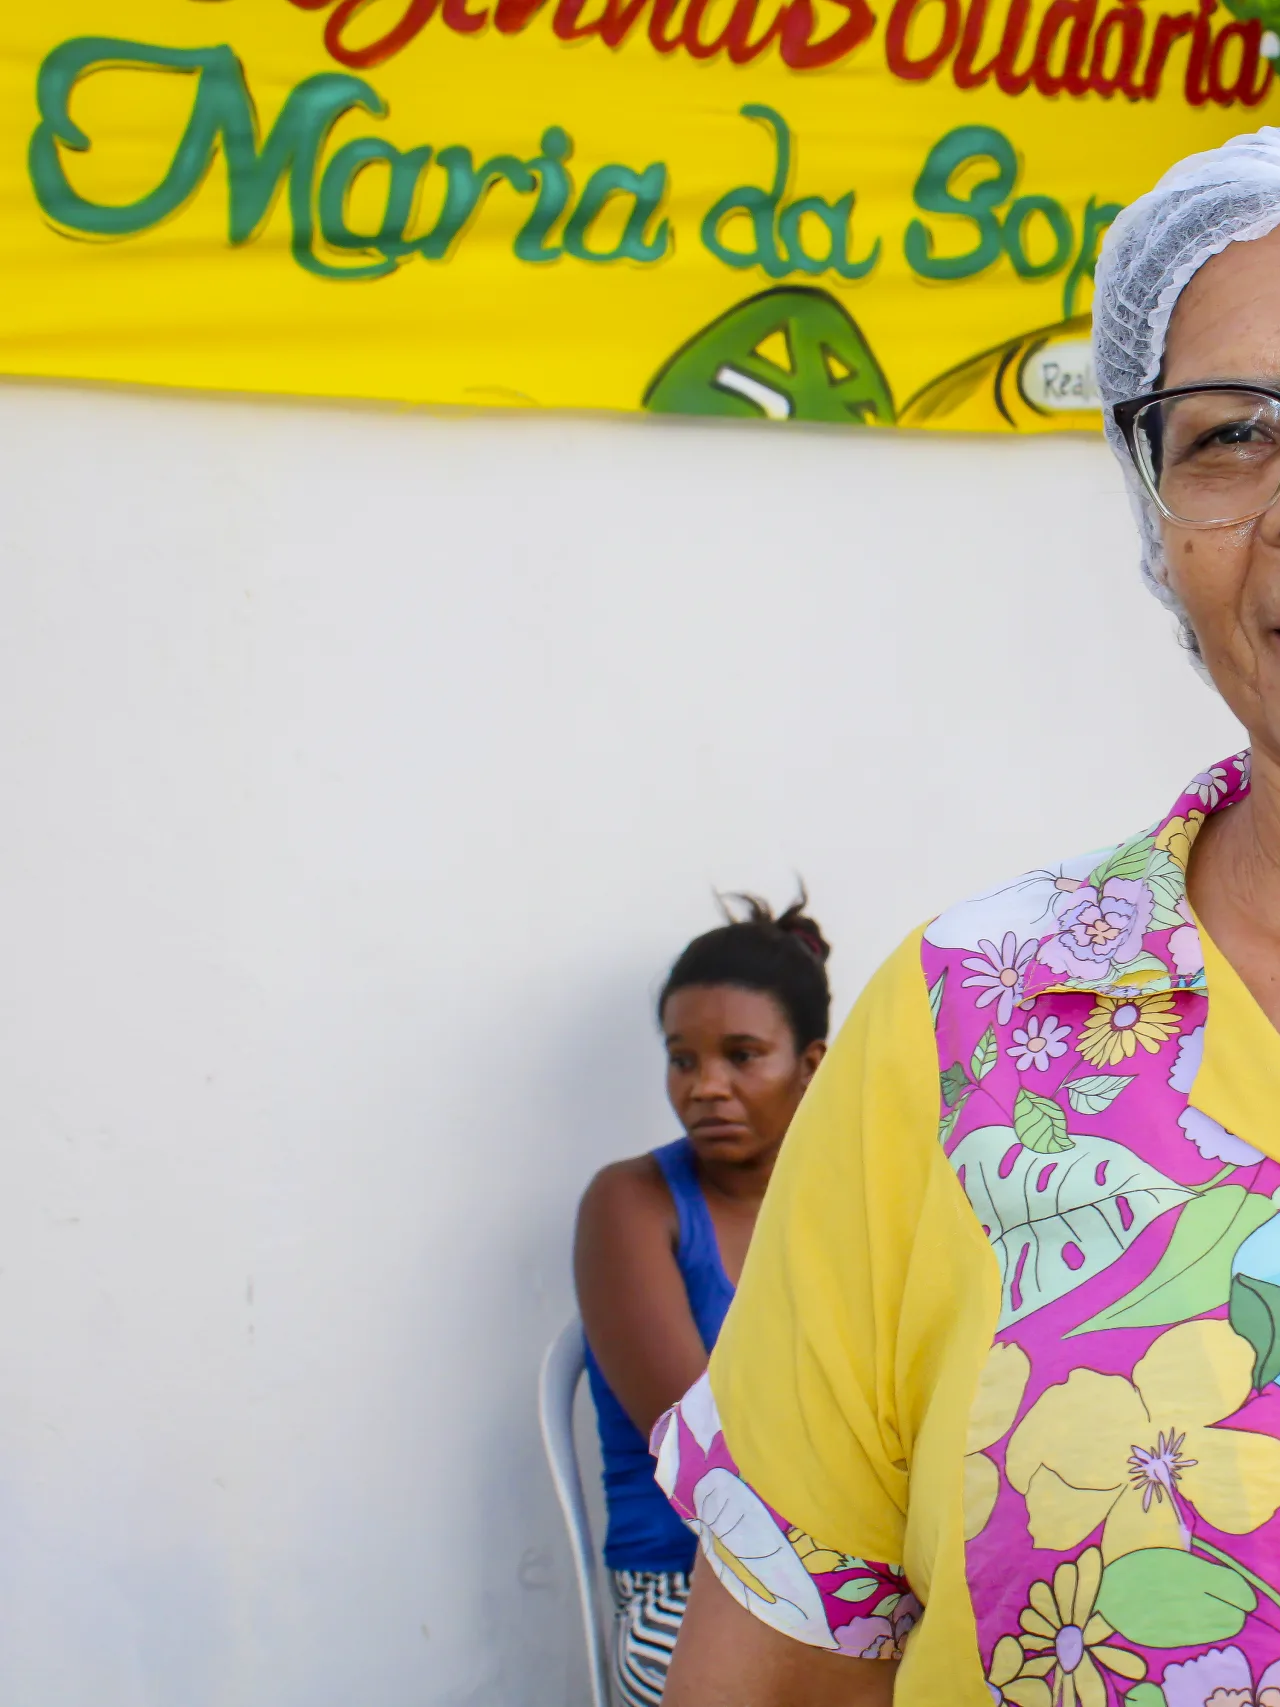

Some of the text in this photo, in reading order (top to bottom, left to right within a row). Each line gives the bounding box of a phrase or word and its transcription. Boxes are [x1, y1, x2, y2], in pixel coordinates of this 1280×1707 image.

[28, 36, 1126, 319] Maria da Sop
